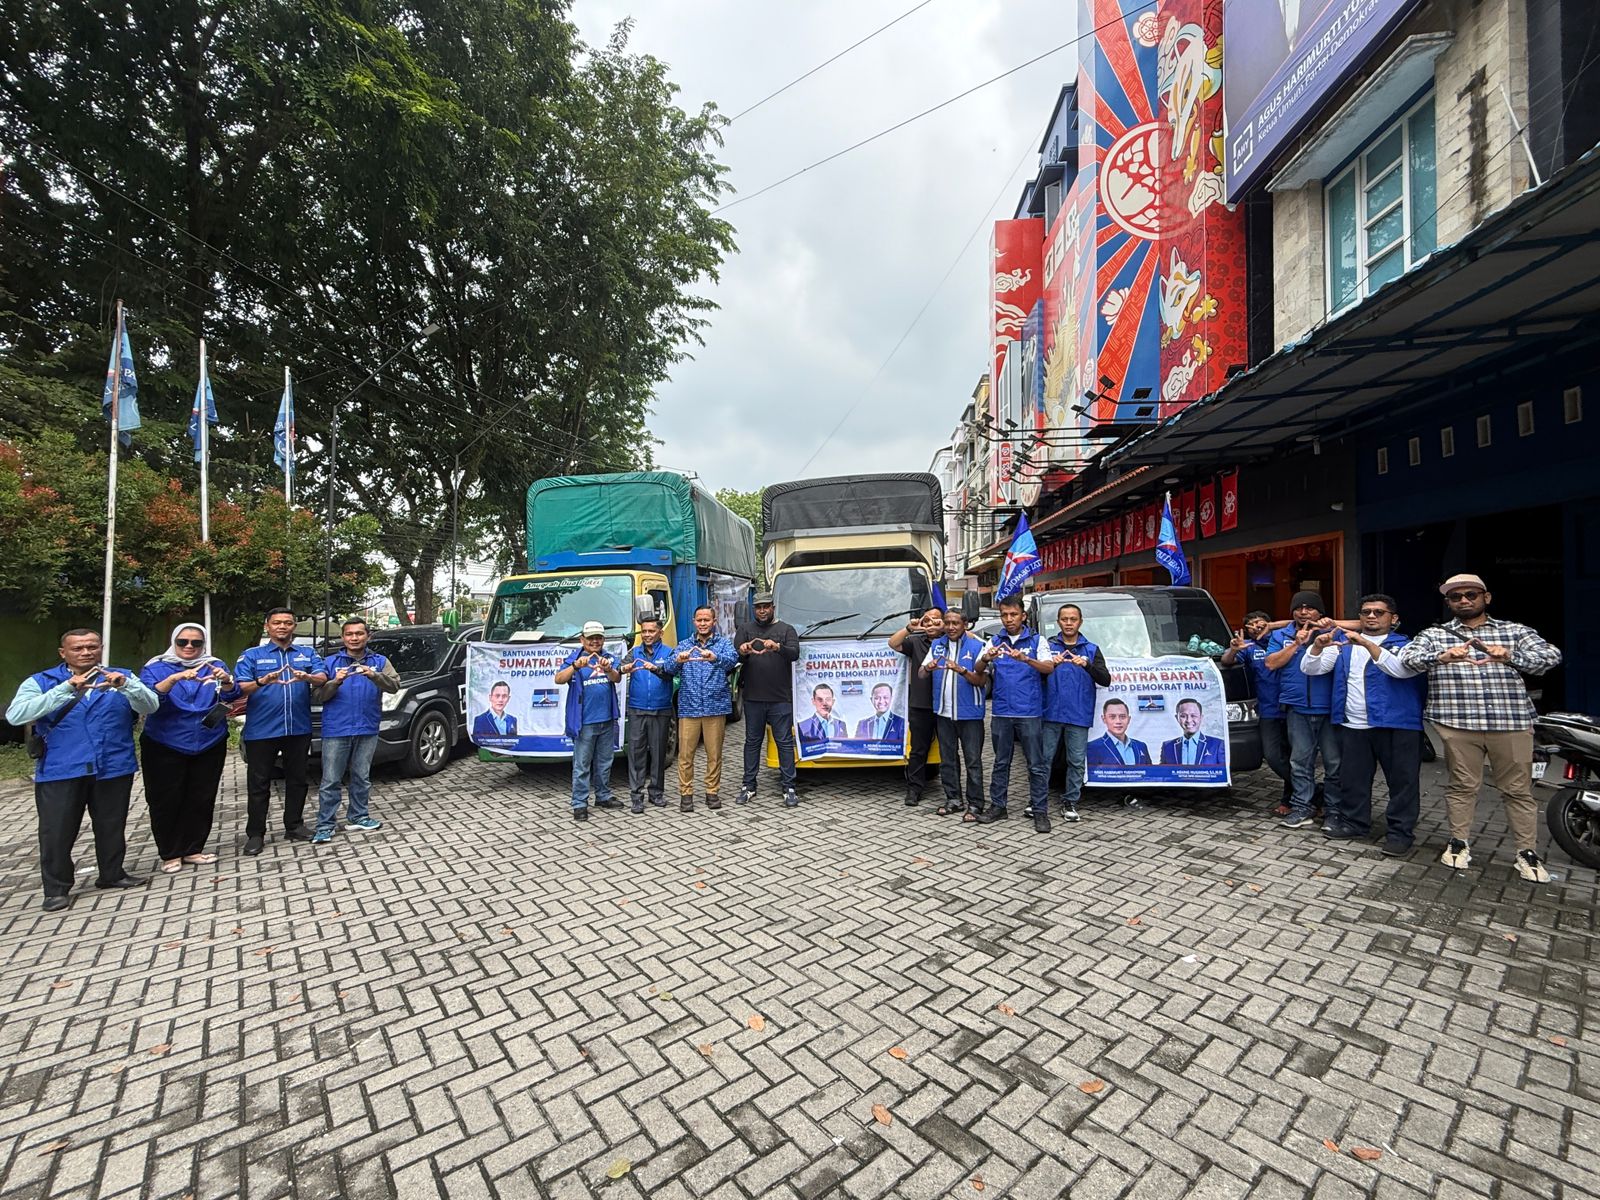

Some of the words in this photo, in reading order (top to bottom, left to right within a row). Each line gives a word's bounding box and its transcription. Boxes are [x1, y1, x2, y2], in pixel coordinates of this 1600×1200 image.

[1258, 92, 1283, 127] AGUS
[1284, 17, 1343, 97] HARIMURTI
[1257, 116, 1278, 143] Ketua
[1278, 87, 1305, 118] Umum
[1304, 53, 1331, 87] Partai
[1236, 138, 1250, 160] AHY
[537, 648, 569, 656] BENCANA
[499, 658, 552, 669] SUMATRA
[805, 660, 859, 670] SUMATRA
[861, 658, 898, 669] BARAT
[511, 669, 528, 678] DPD
[528, 669, 558, 677] DEMOK
[818, 671, 834, 679] DPD
[835, 669, 878, 678] DEMOKRAT
[1111, 671, 1159, 683] MATRA
[1160, 671, 1205, 681] BARAT
[1129, 683, 1182, 691] DEMOKRAT
[1184, 682, 1207, 690] RIAU
